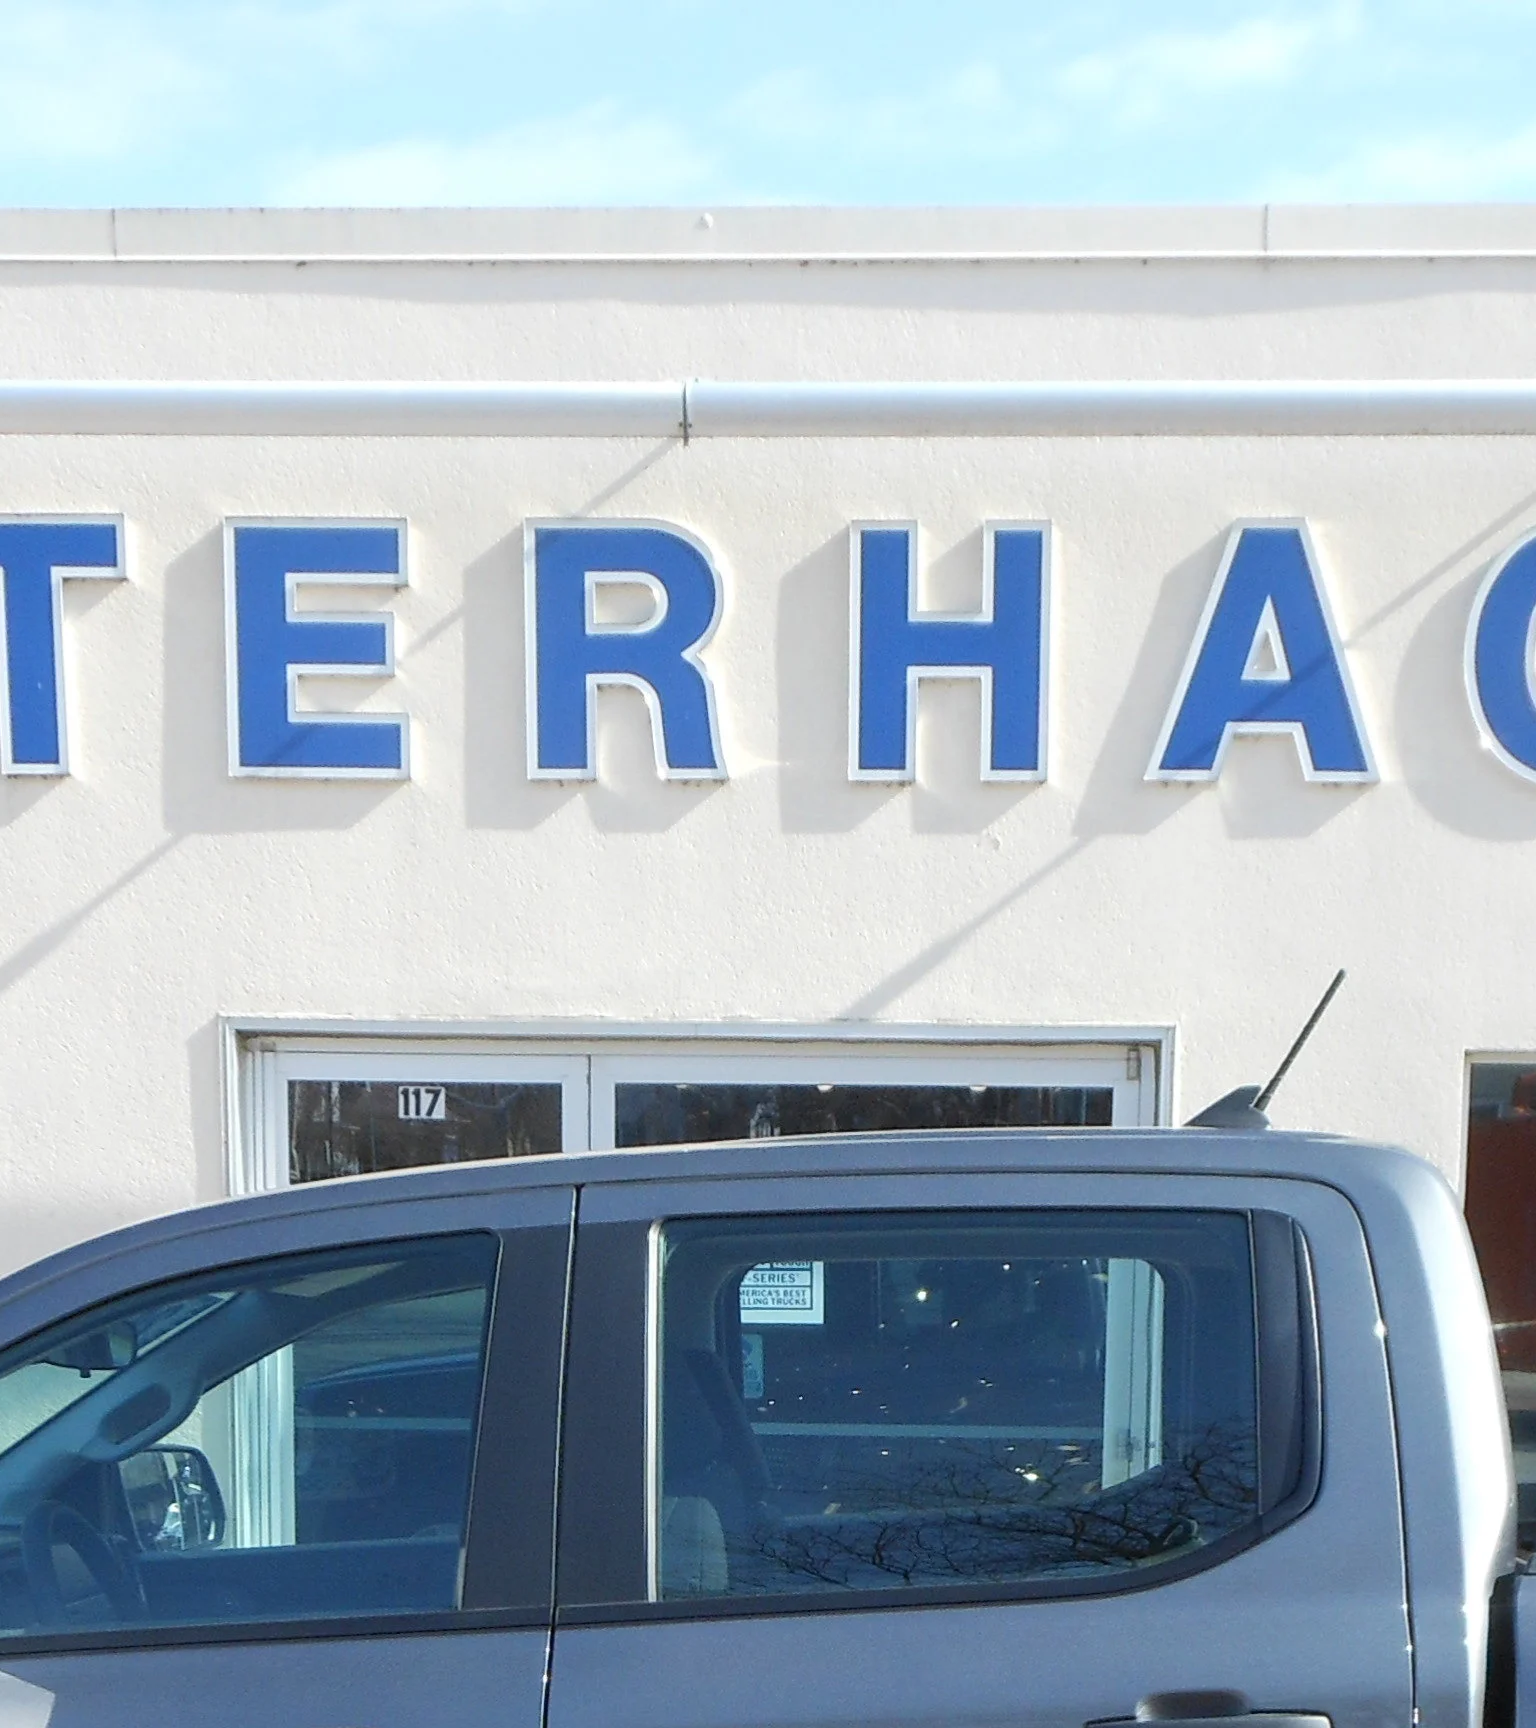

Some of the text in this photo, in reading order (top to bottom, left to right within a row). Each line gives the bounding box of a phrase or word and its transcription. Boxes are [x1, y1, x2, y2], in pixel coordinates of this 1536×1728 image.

[399, 1087, 443, 1117] 117
[740, 1289, 806, 1298] MERICA'S BEST
[742, 1298, 807, 1306] LLING TRUCKS
